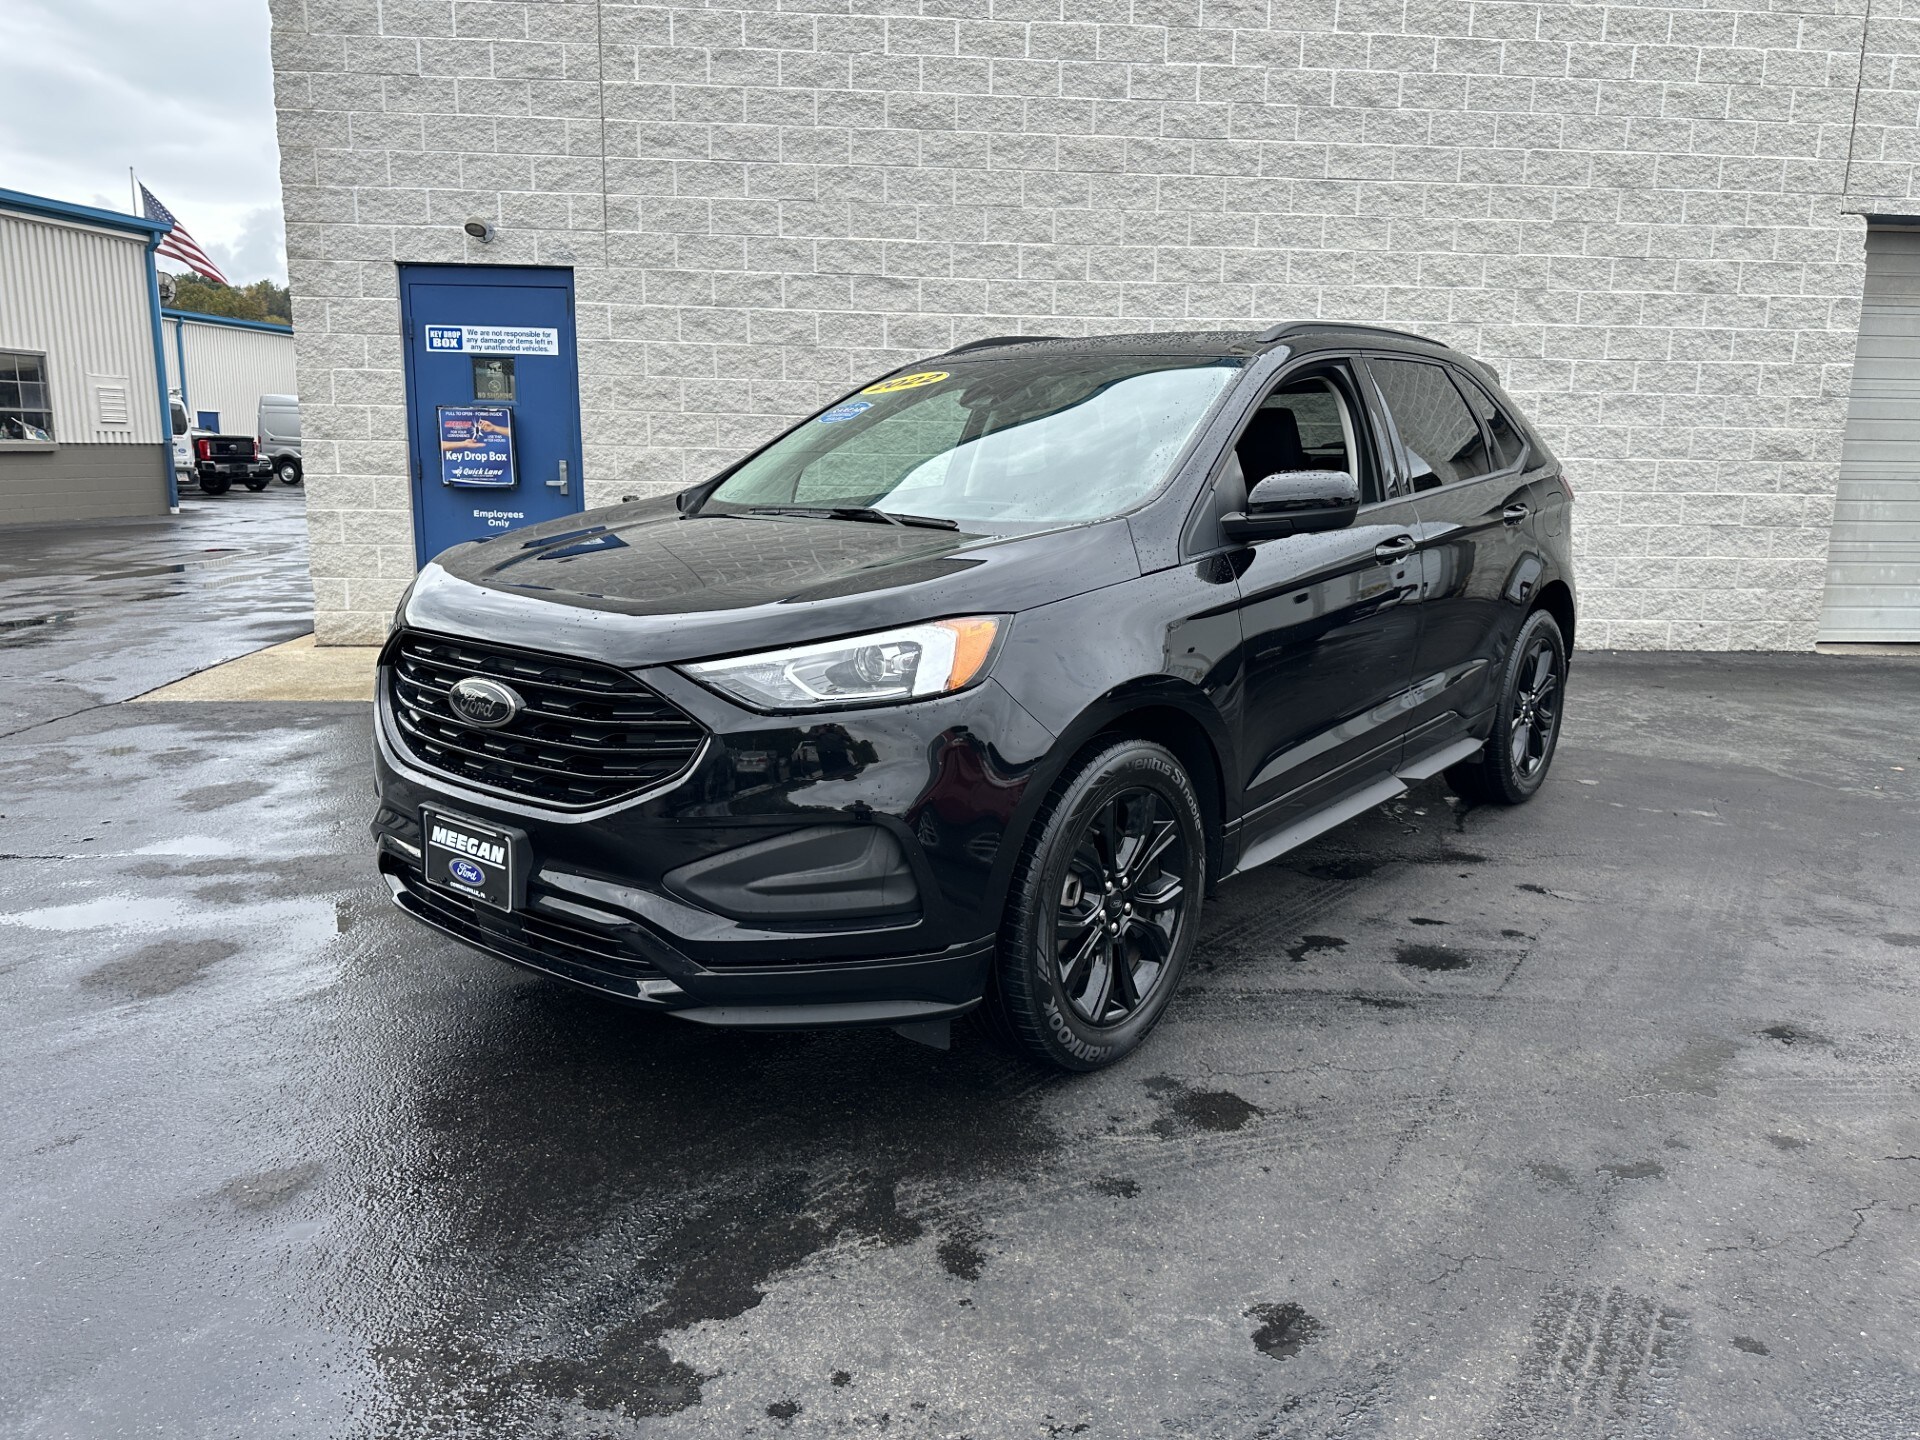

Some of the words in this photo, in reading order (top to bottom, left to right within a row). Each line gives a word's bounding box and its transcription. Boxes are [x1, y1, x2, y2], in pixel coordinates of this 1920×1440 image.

[430, 330, 442, 338] KEY
[443, 331, 461, 339] DROP
[433, 338, 458, 348] BOX
[480, 337, 505, 345] damage
[446, 451, 463, 462] Key
[464, 451, 488, 463] Drop
[489, 451, 508, 461] Box
[463, 467, 484, 475] Quick
[484, 467, 504, 475] Lane
[473, 510, 524, 519] Employees
[488, 519, 510, 528] Only
[1171, 768, 1186, 790] S1
[1183, 788, 1201, 831] noble
[431, 825, 505, 864] MEEGAN
[456, 862, 477, 881] Ford
